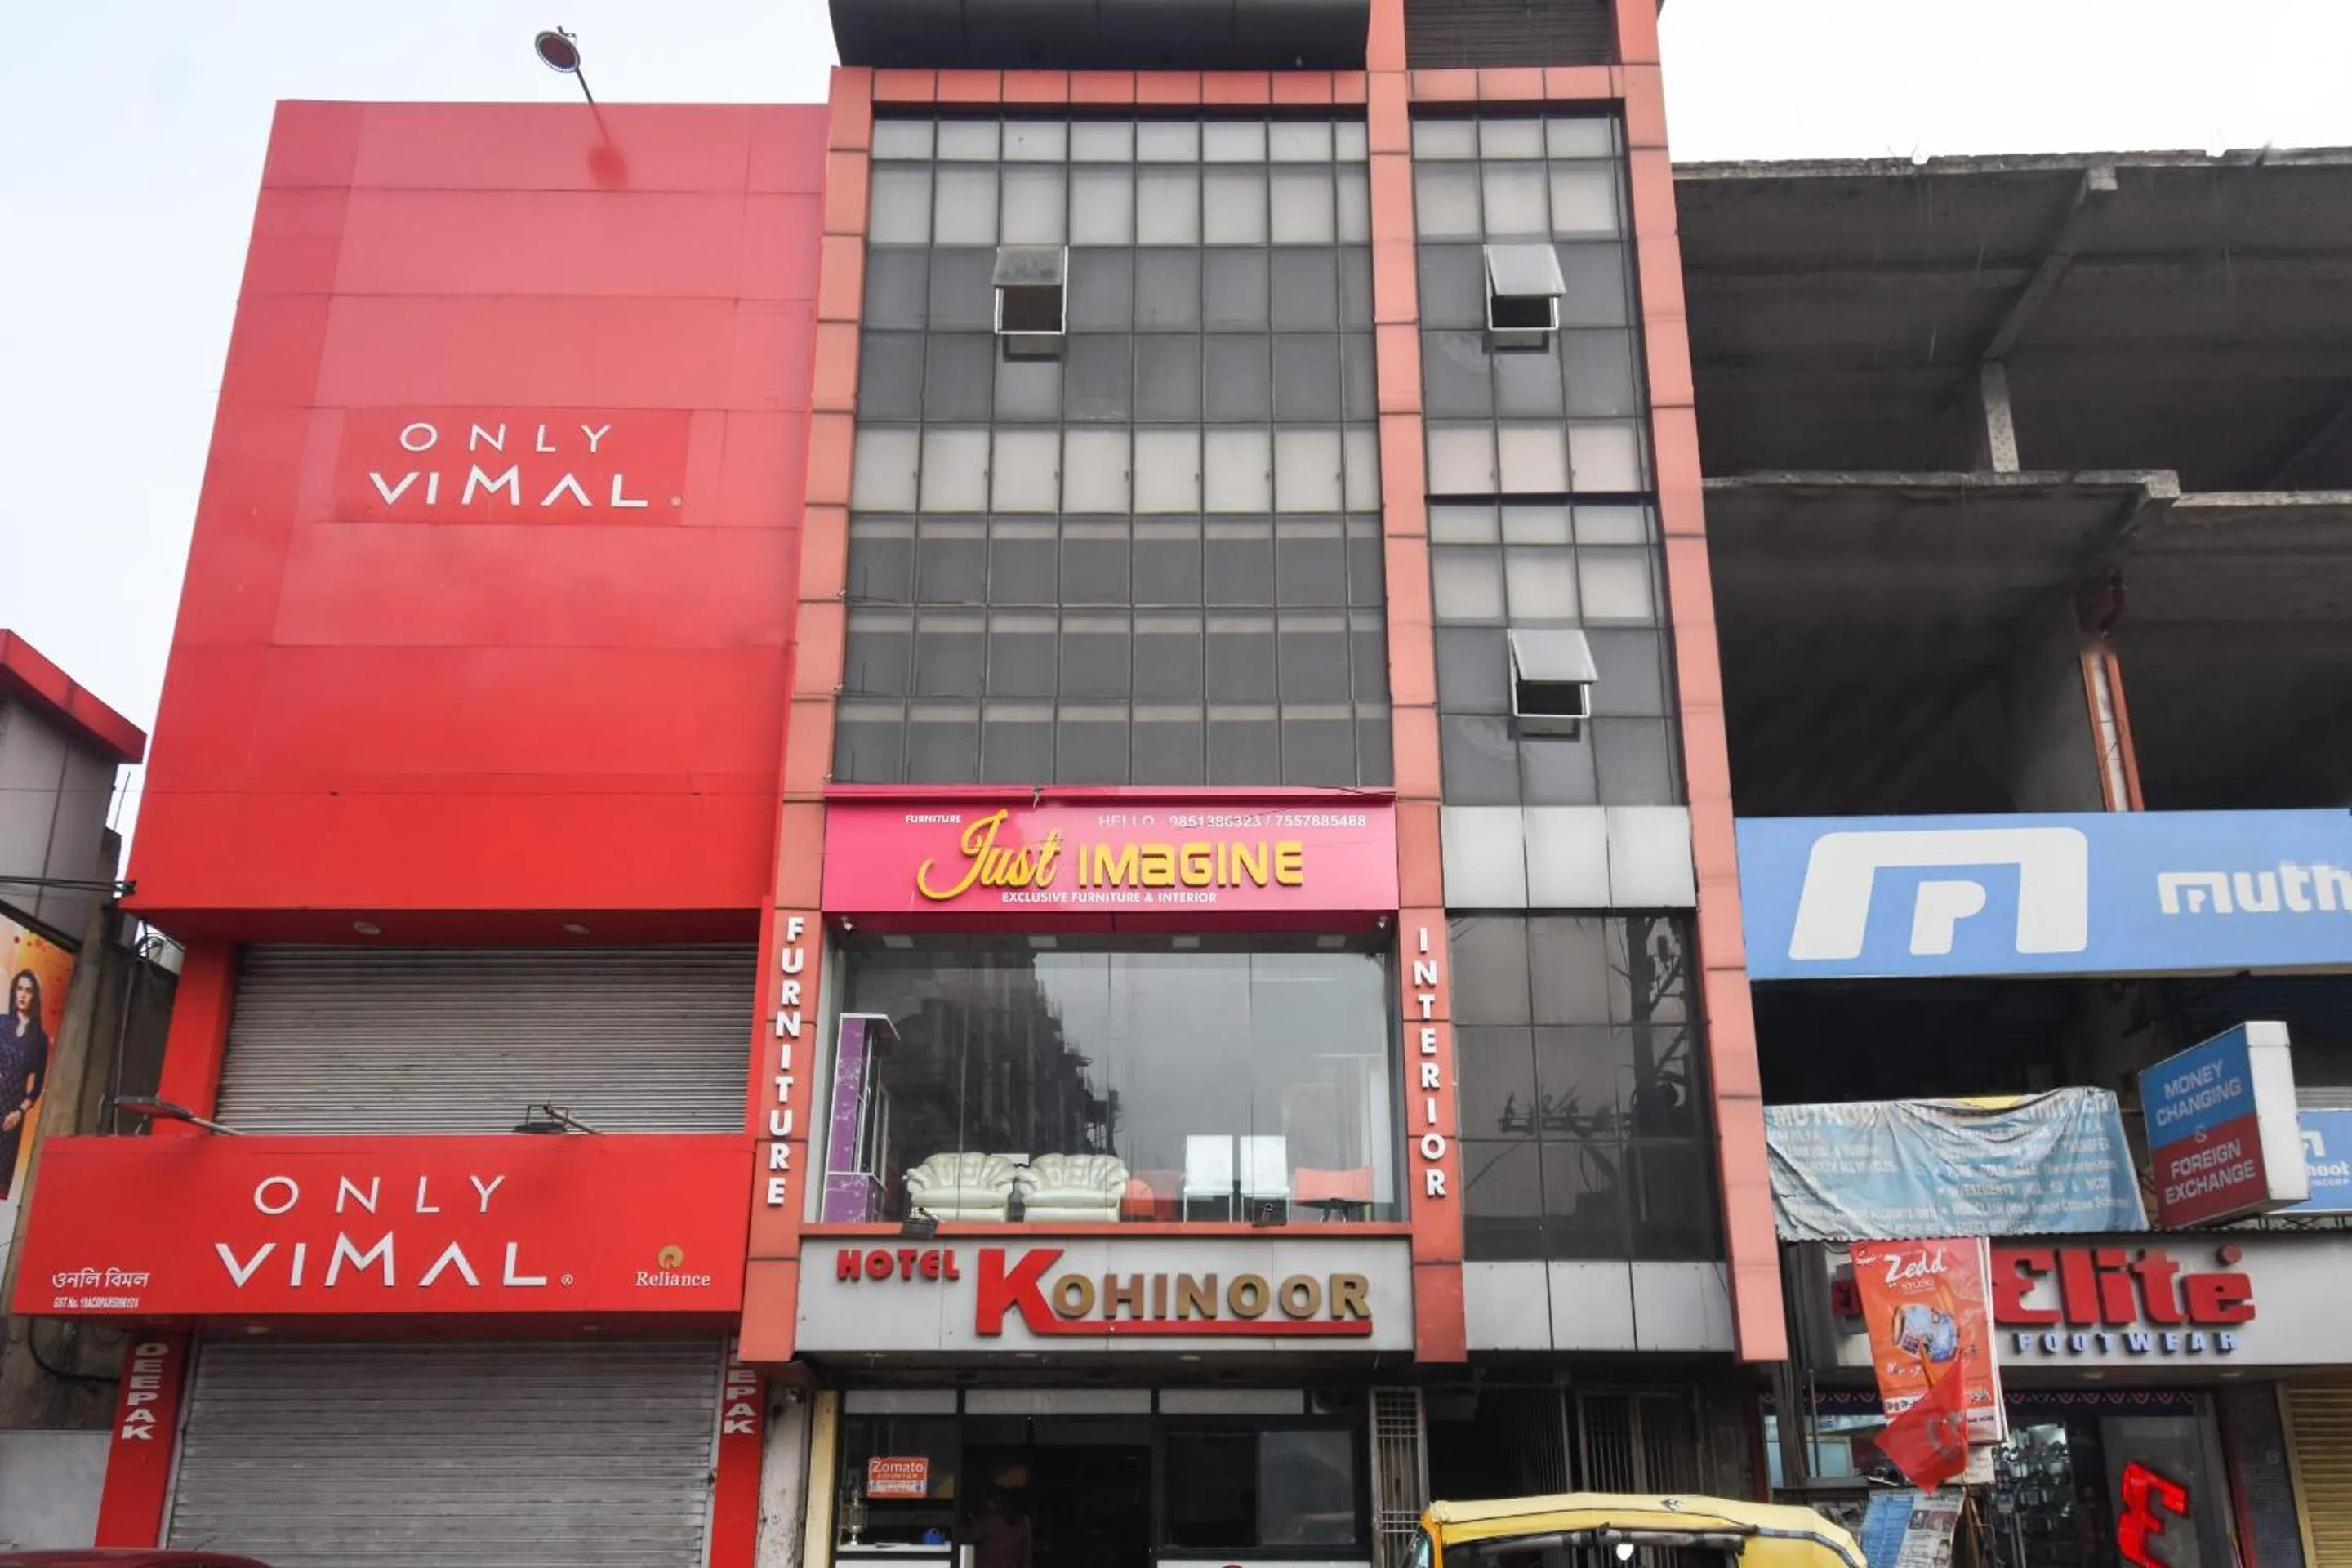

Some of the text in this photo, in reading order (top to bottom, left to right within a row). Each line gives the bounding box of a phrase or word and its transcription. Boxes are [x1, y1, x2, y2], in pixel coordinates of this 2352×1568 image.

[399, 422, 611, 452] ONLY
[368, 463, 648, 507] VIMAL
[905, 813, 962, 823] FURNITURE
[1098, 815, 1155, 826] HELLO
[916, 808, 1062, 902] Just
[1002, 891, 1217, 903] EXCLUSIVE FURNITURE & INTERIOR
[767, 915, 804, 1206] FURNITURE
[1412, 927, 1447, 1198] INTERIOR
[2163, 1058, 2224, 1100] MONEY
[2156, 1077, 2243, 1127] CHANGING
[2194, 1124, 2207, 1143] &
[2170, 1138, 2242, 1179] FOREIGN
[254, 1174, 505, 1215] ONLY
[2165, 1160, 2256, 1205] EXCHANGE
[105, 1267, 150, 1288] বিমল
[215, 1231, 547, 1288] VIMAL
[634, 1271, 711, 1287] Reliance
[1883, 1246, 1947, 1284] Zedd
[835, 1248, 1373, 1336] HOTEL KOHINOOR
[1990, 1248, 2256, 1325] Elite
[2018, 1331, 2238, 1353] FOOTWEAR
[121, 1343, 169, 1440] DEEPAK
[871, 1460, 924, 1473] Zomato
